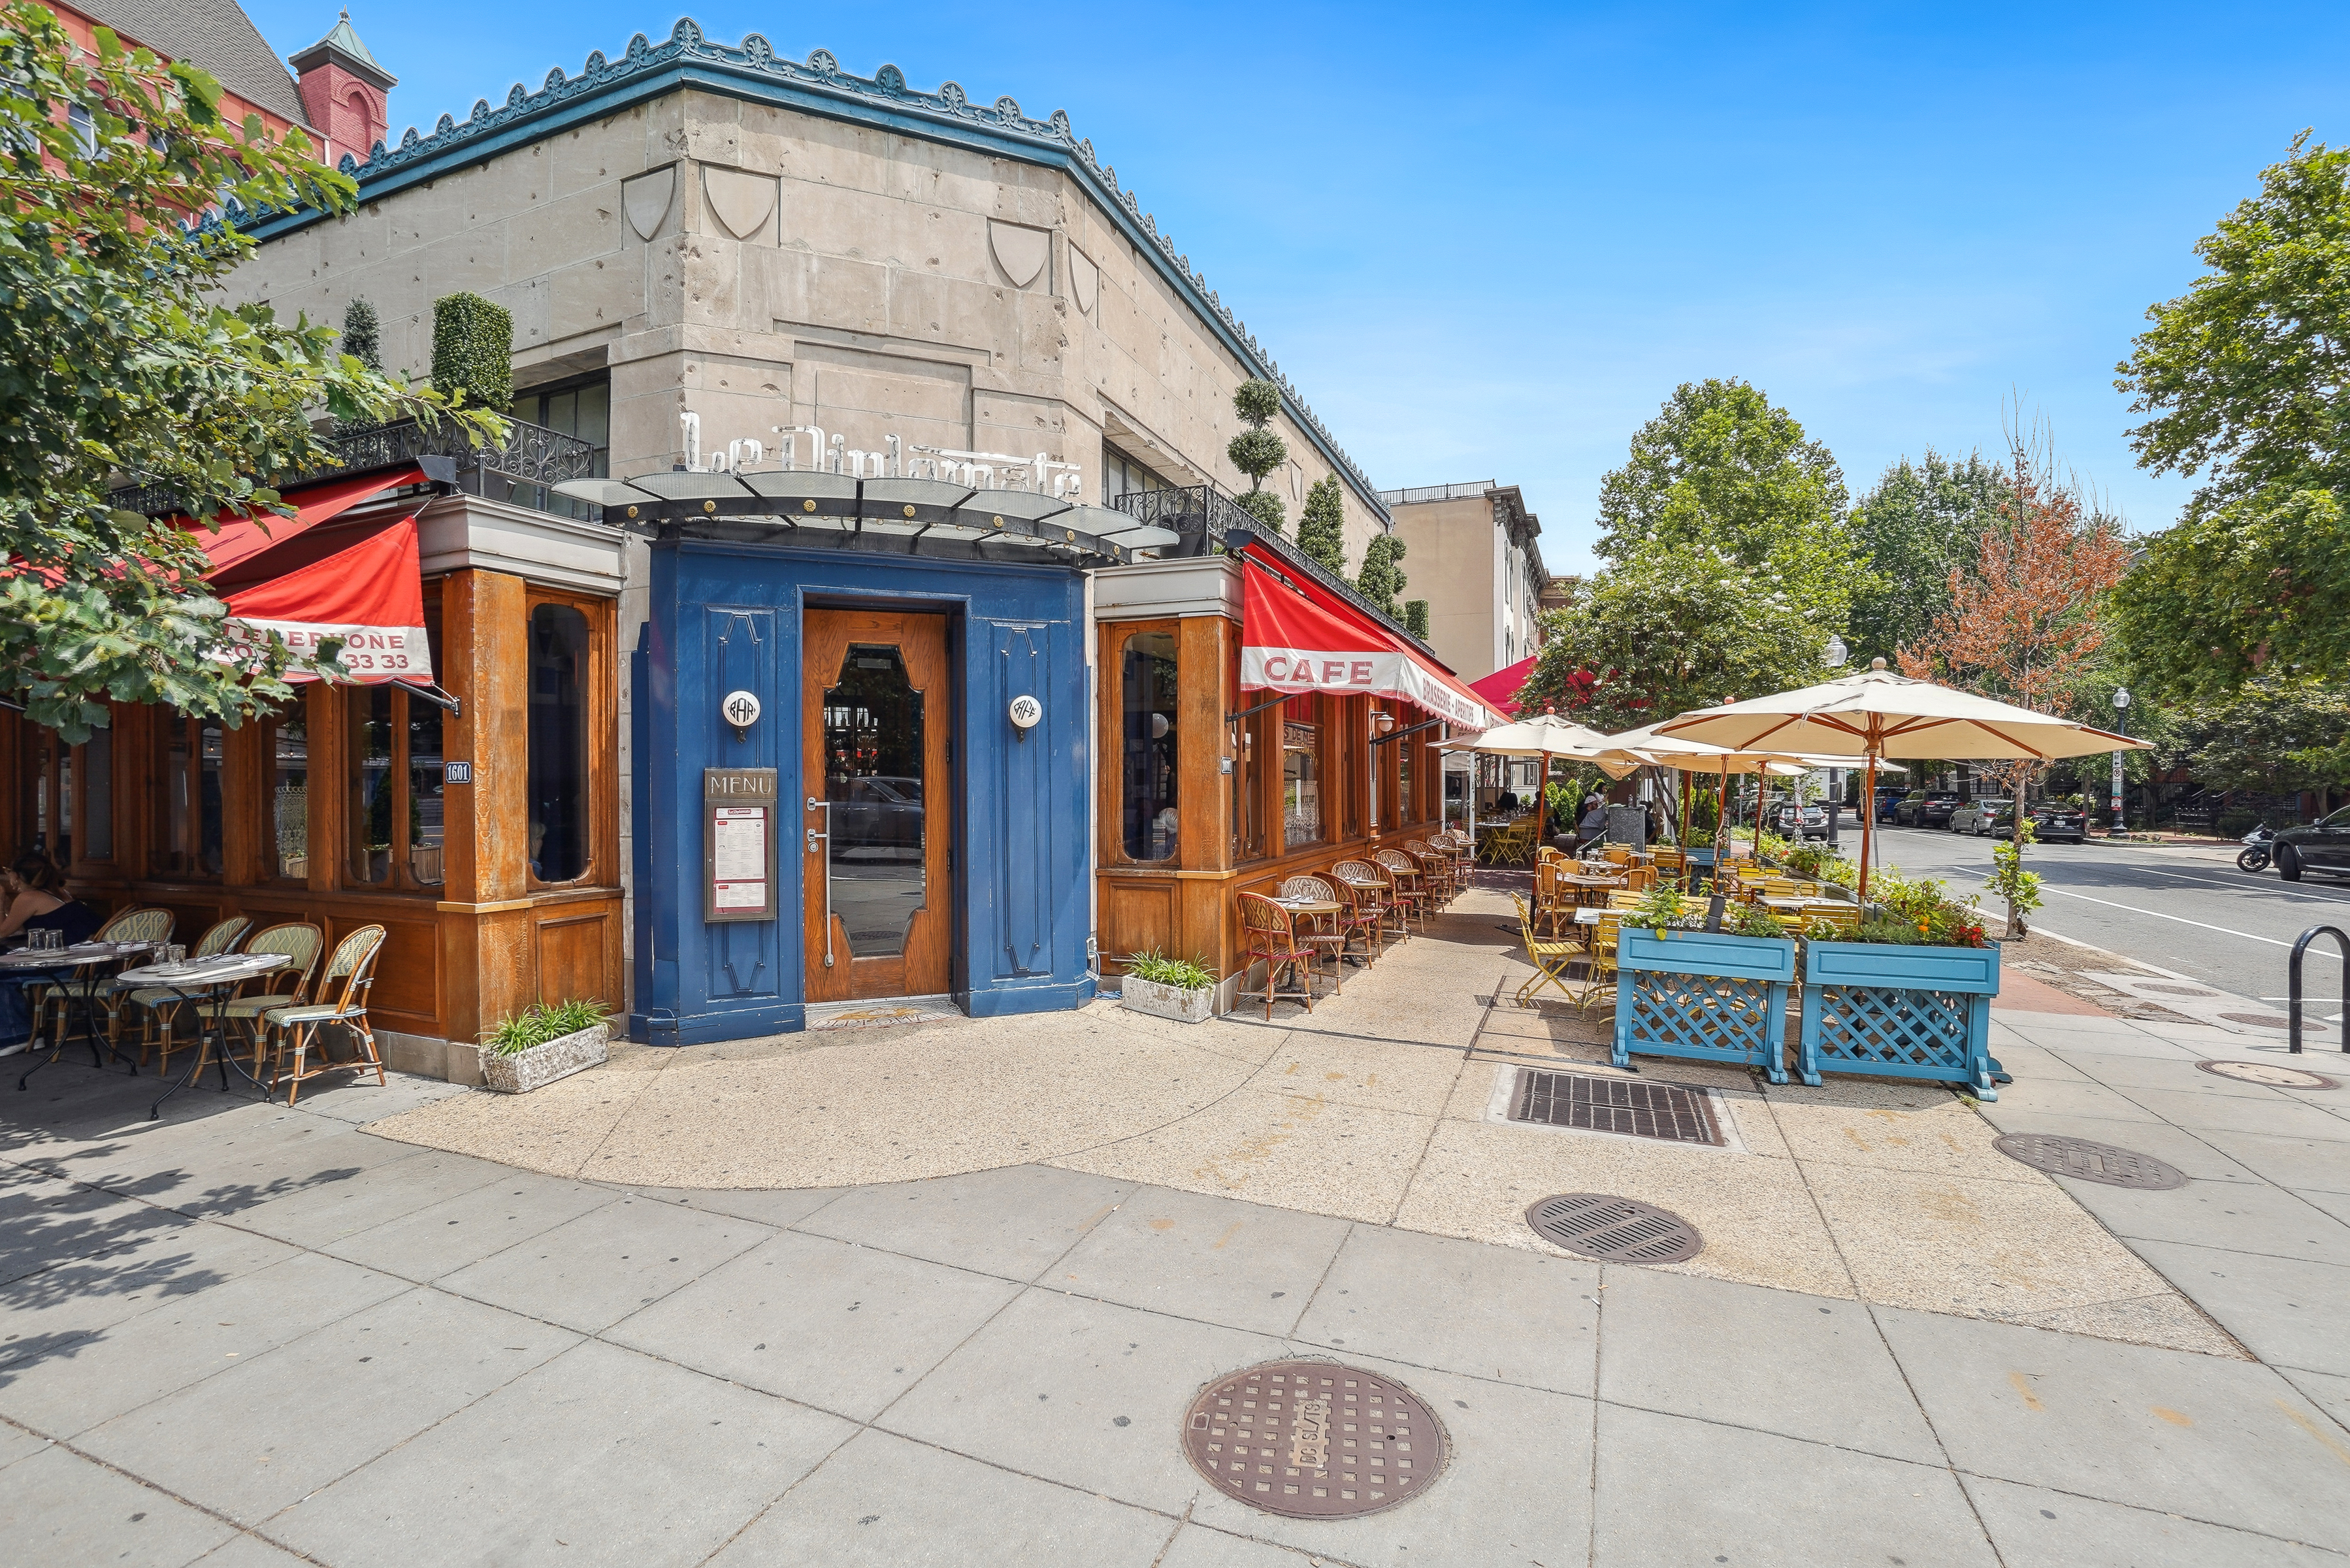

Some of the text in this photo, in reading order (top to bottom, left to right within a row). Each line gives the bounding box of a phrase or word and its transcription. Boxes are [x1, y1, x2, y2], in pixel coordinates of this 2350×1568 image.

[680, 412, 762, 476] Le
[223, 623, 405, 649] TEEPONE
[345, 654, 374, 669] 33
[381, 654, 409, 669] 33
[1264, 657, 1373, 685] CAFE
[1423, 678, 1451, 713] BRASSERIE
[728, 698, 755, 723] BAR
[448, 764, 468, 780] 1601
[710, 776, 772, 794] MENU
[1300, 1448, 1317, 1463] DC
